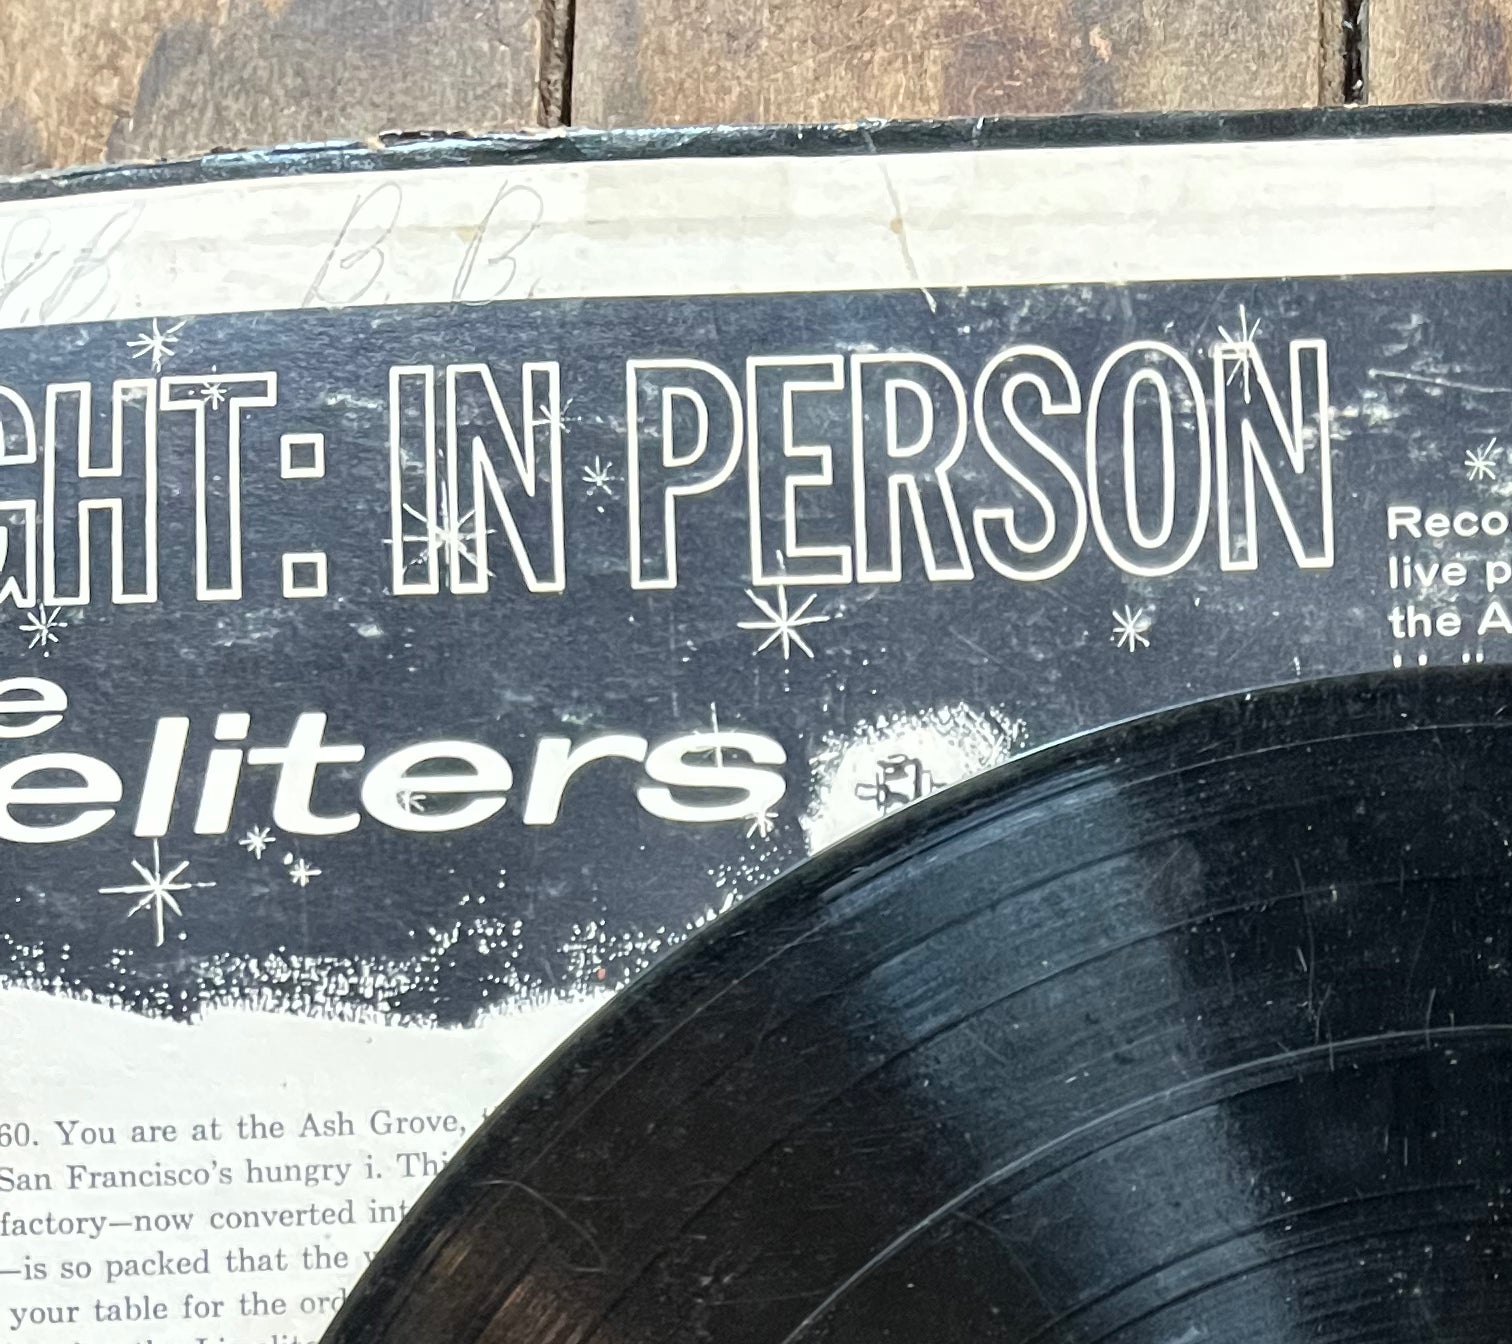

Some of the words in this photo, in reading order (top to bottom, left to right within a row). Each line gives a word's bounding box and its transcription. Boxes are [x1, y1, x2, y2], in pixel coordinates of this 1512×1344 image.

[388, 361, 566, 596] IN
[626, 333, 1334, 590] PERSON
[1387, 557, 1469, 591] live
[1389, 606, 1462, 641] the
[53, 1119, 117, 1146] You
[131, 1124, 178, 1143] are
[191, 1117, 222, 1142] at
[236, 1113, 285, 1140] the
[298, 1110, 355, 1138] Ash
[369, 1109, 466, 1137] Grove,
[65, 1159, 233, 1190] Francisco's
[245, 1158, 352, 1187] hungry
[209, 1198, 357, 1230] converted
[60, 1261, 92, 1280] so
[105, 1248, 211, 1284] packed
[225, 1246, 289, 1273] that
[302, 1244, 349, 1271] the
[9, 1306, 80, 1332] your
[93, 1294, 168, 1323] table
[183, 1293, 225, 1320] for
[238, 1290, 287, 1317] the
